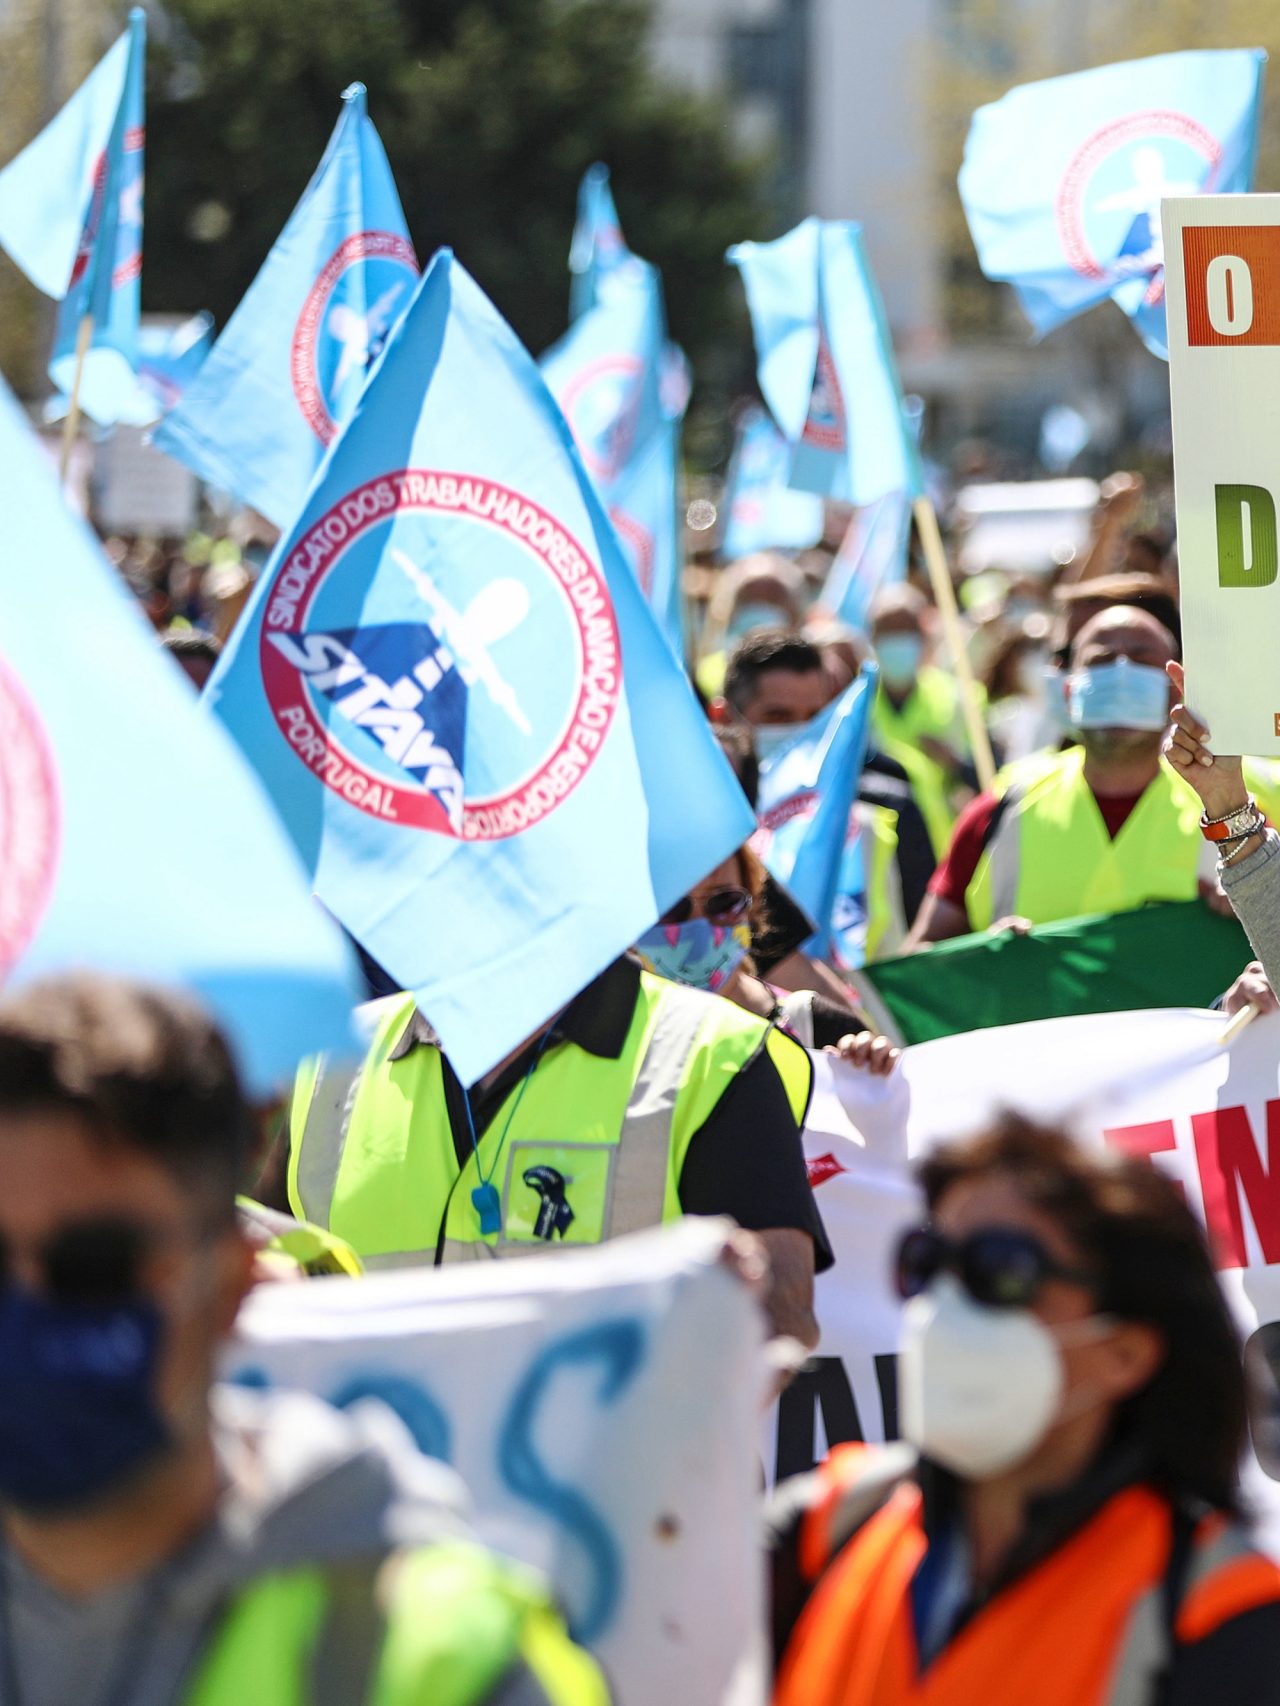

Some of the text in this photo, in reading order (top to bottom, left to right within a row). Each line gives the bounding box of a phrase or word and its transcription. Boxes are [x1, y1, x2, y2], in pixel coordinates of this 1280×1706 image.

[1206, 255, 1253, 336] O
[267, 515, 349, 630] SINDICATO
[340, 480, 397, 528] DOS
[393, 473, 589, 586] TRABALHADORES
[264, 631, 465, 839] SITAVA
[278, 705, 399, 819] PORTUGAL
